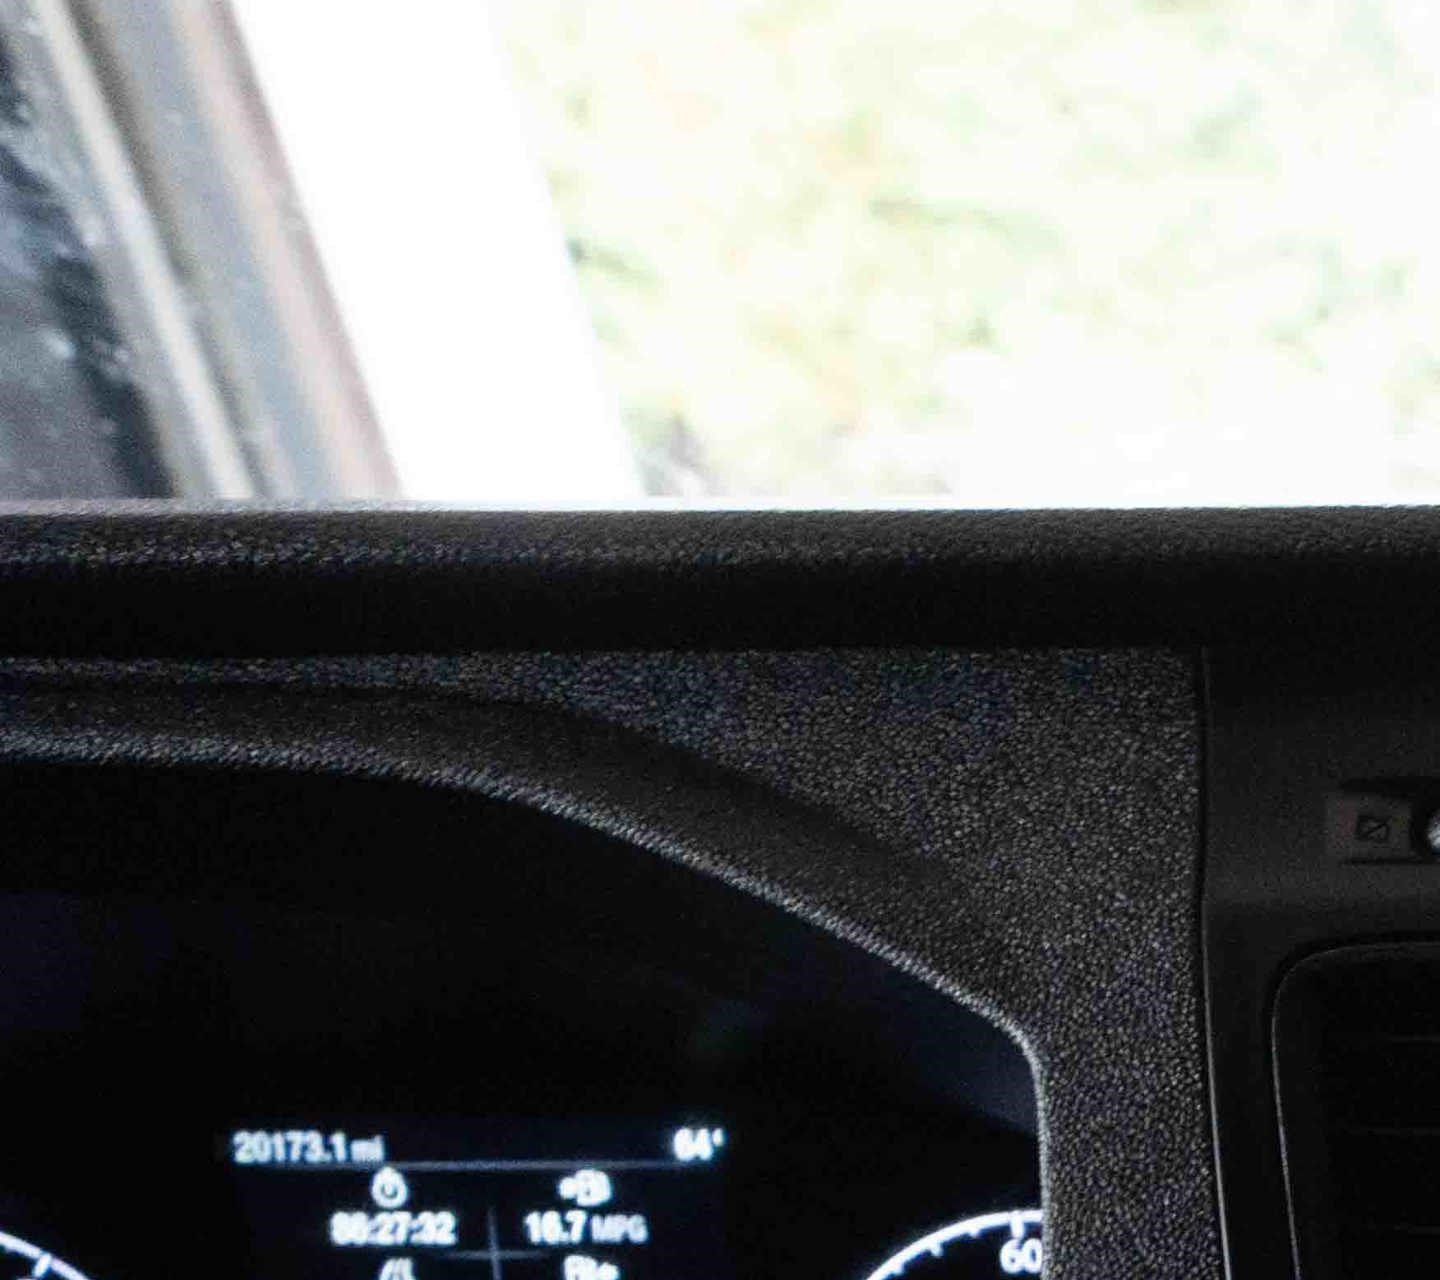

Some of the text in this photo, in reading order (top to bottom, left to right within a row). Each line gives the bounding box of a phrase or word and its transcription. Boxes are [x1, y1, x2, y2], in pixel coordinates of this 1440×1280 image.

[233, 1131, 385, 1165] 20173.1 mi
[1001, 1235, 1040, 1273] 60
